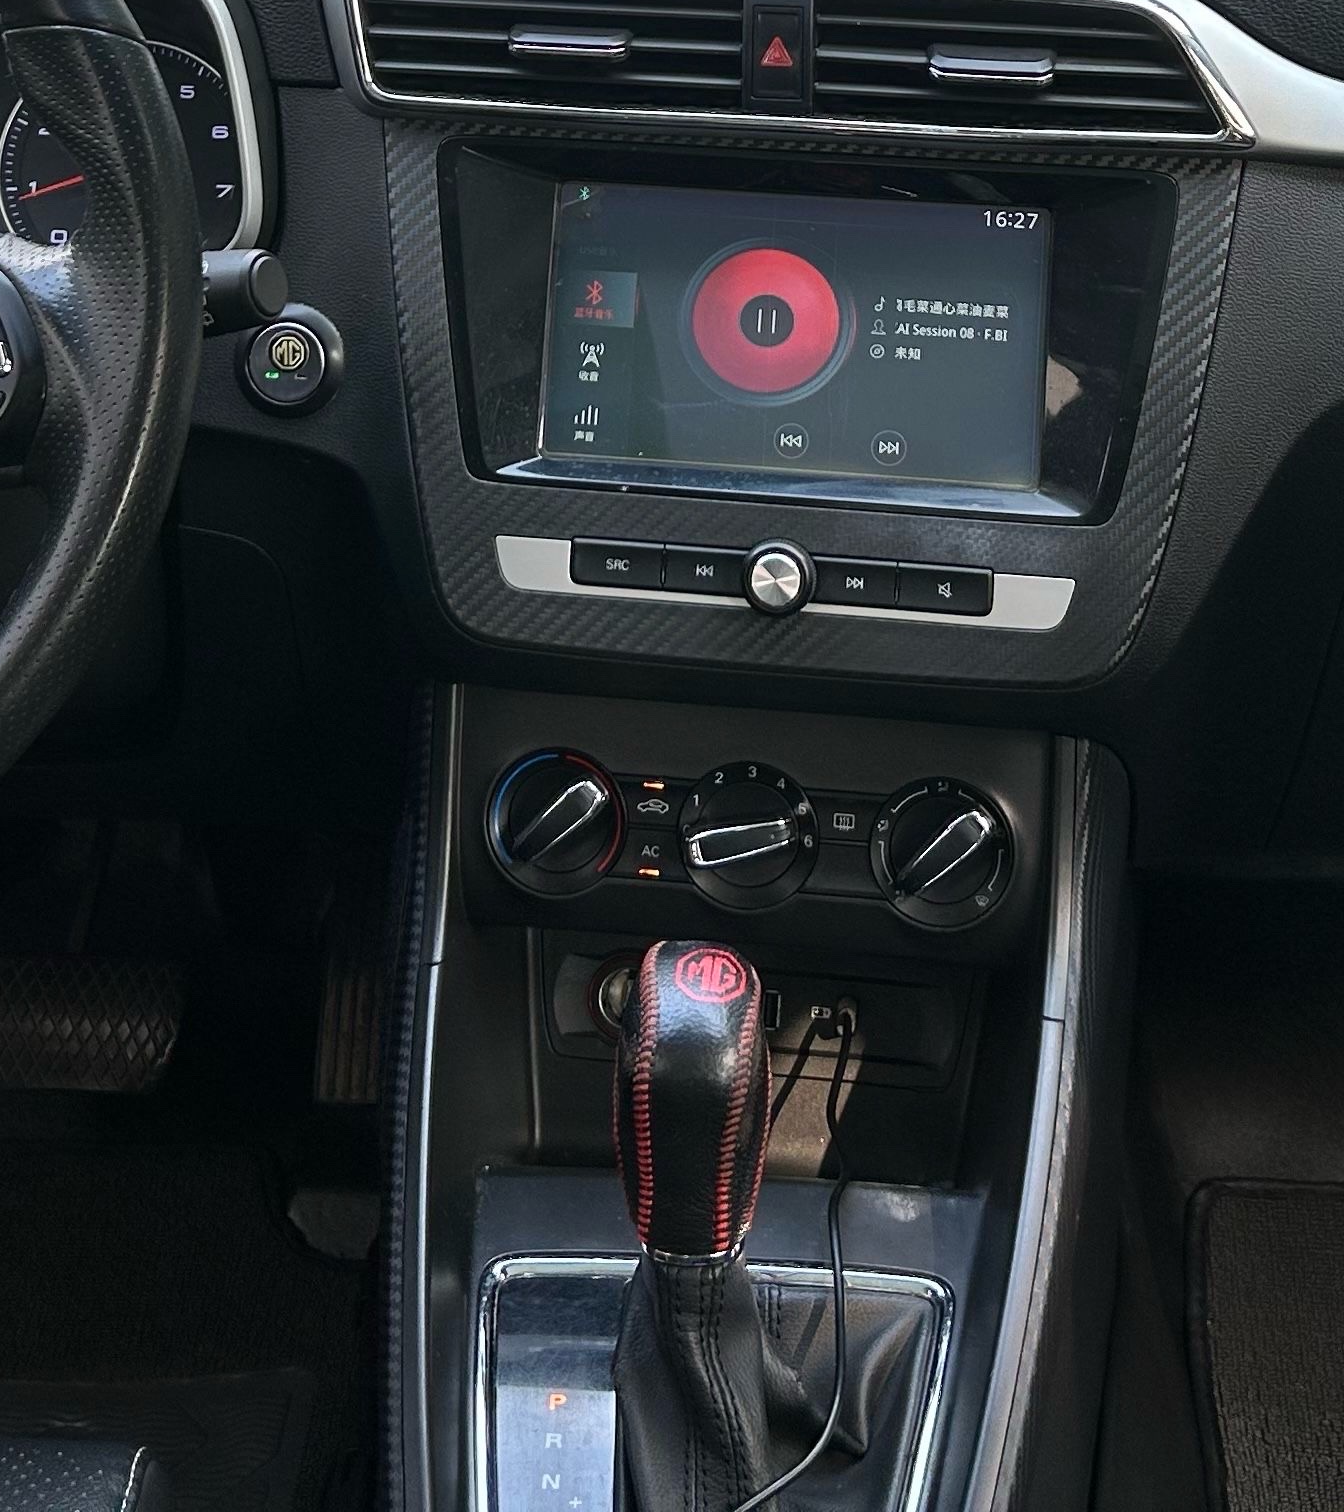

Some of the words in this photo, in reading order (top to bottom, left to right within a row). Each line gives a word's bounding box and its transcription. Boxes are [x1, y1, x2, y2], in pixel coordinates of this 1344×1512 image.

[180, 85, 195, 99] 5
[211, 125, 229, 139] 6
[28, 181, 38, 195] 1
[215, 184, 235, 199] 7
[983, 210, 1039, 230] 16:27
[50, 229, 68, 244] 0
[913, 323, 957, 338] Session
[959, 327, 975, 339] 08
[275, 339, 302, 367] MG
[894, 346, 921, 361] 未知
[605, 558, 631, 571] SRC
[714, 771, 724, 784] 2
[748, 766, 757, 778] 3
[776, 777, 785, 790] 4
[693, 794, 700, 807] 1
[804, 835, 813, 848] 6
[641, 845, 660, 857] AC
[685, 953, 739, 995] MG
[549, 1393, 567, 1410] P
[545, 1433, 563, 1448] R
[542, 1473, 561, 1489] N
